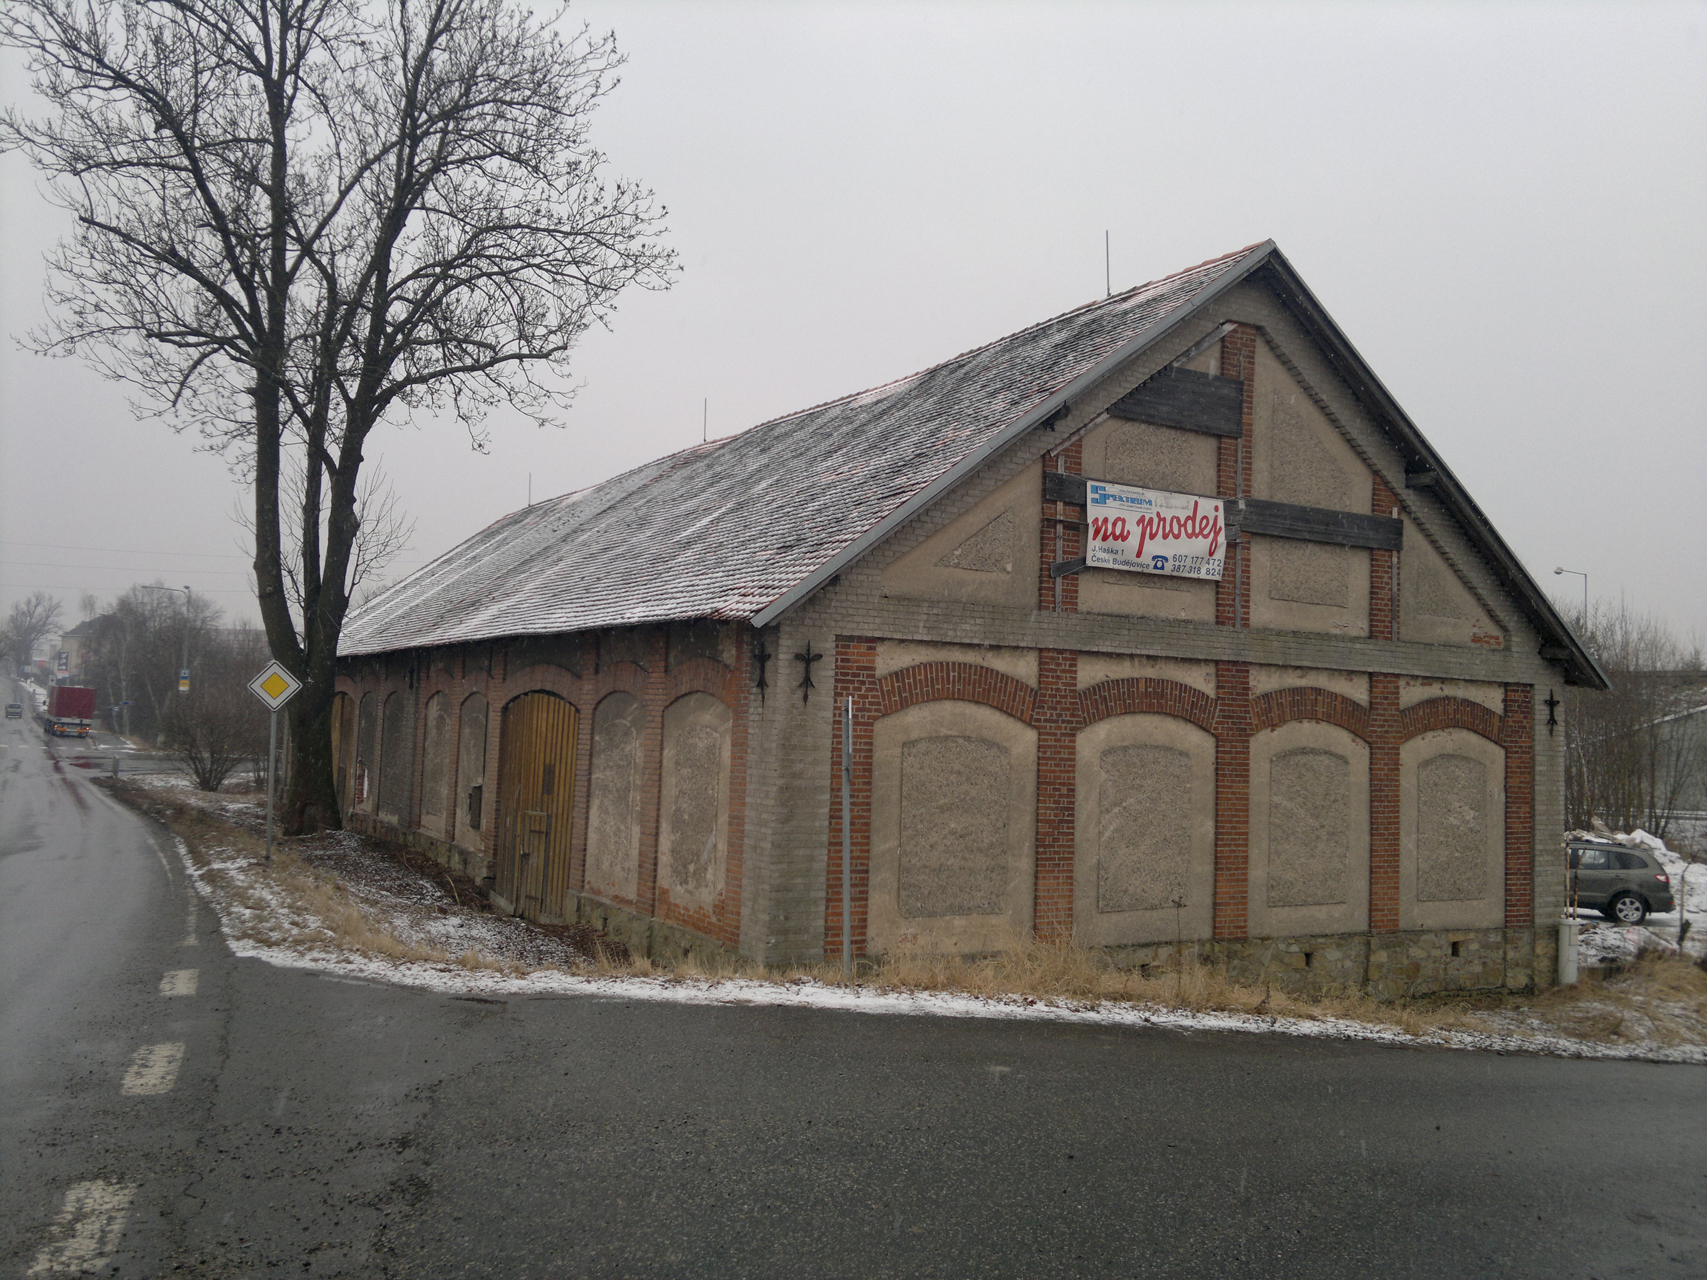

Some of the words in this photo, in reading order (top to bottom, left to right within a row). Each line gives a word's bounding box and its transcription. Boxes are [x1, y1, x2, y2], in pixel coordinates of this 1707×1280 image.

[1091, 484, 1153, 506] SPEKTRUM
[1091, 516, 1131, 542] na
[1136, 500, 1222, 558] prodej
[1091, 553, 1110, 564] České
[1112, 557, 1150, 569] Budějovice
[1172, 554, 1188, 563] 607
[1191, 556, 1204, 565] 177
[1206, 558, 1222, 567] 472
[1171, 564, 1186, 573] 387
[1188, 566, 1202, 575] 318
[1206, 568, 1221, 577] 824
